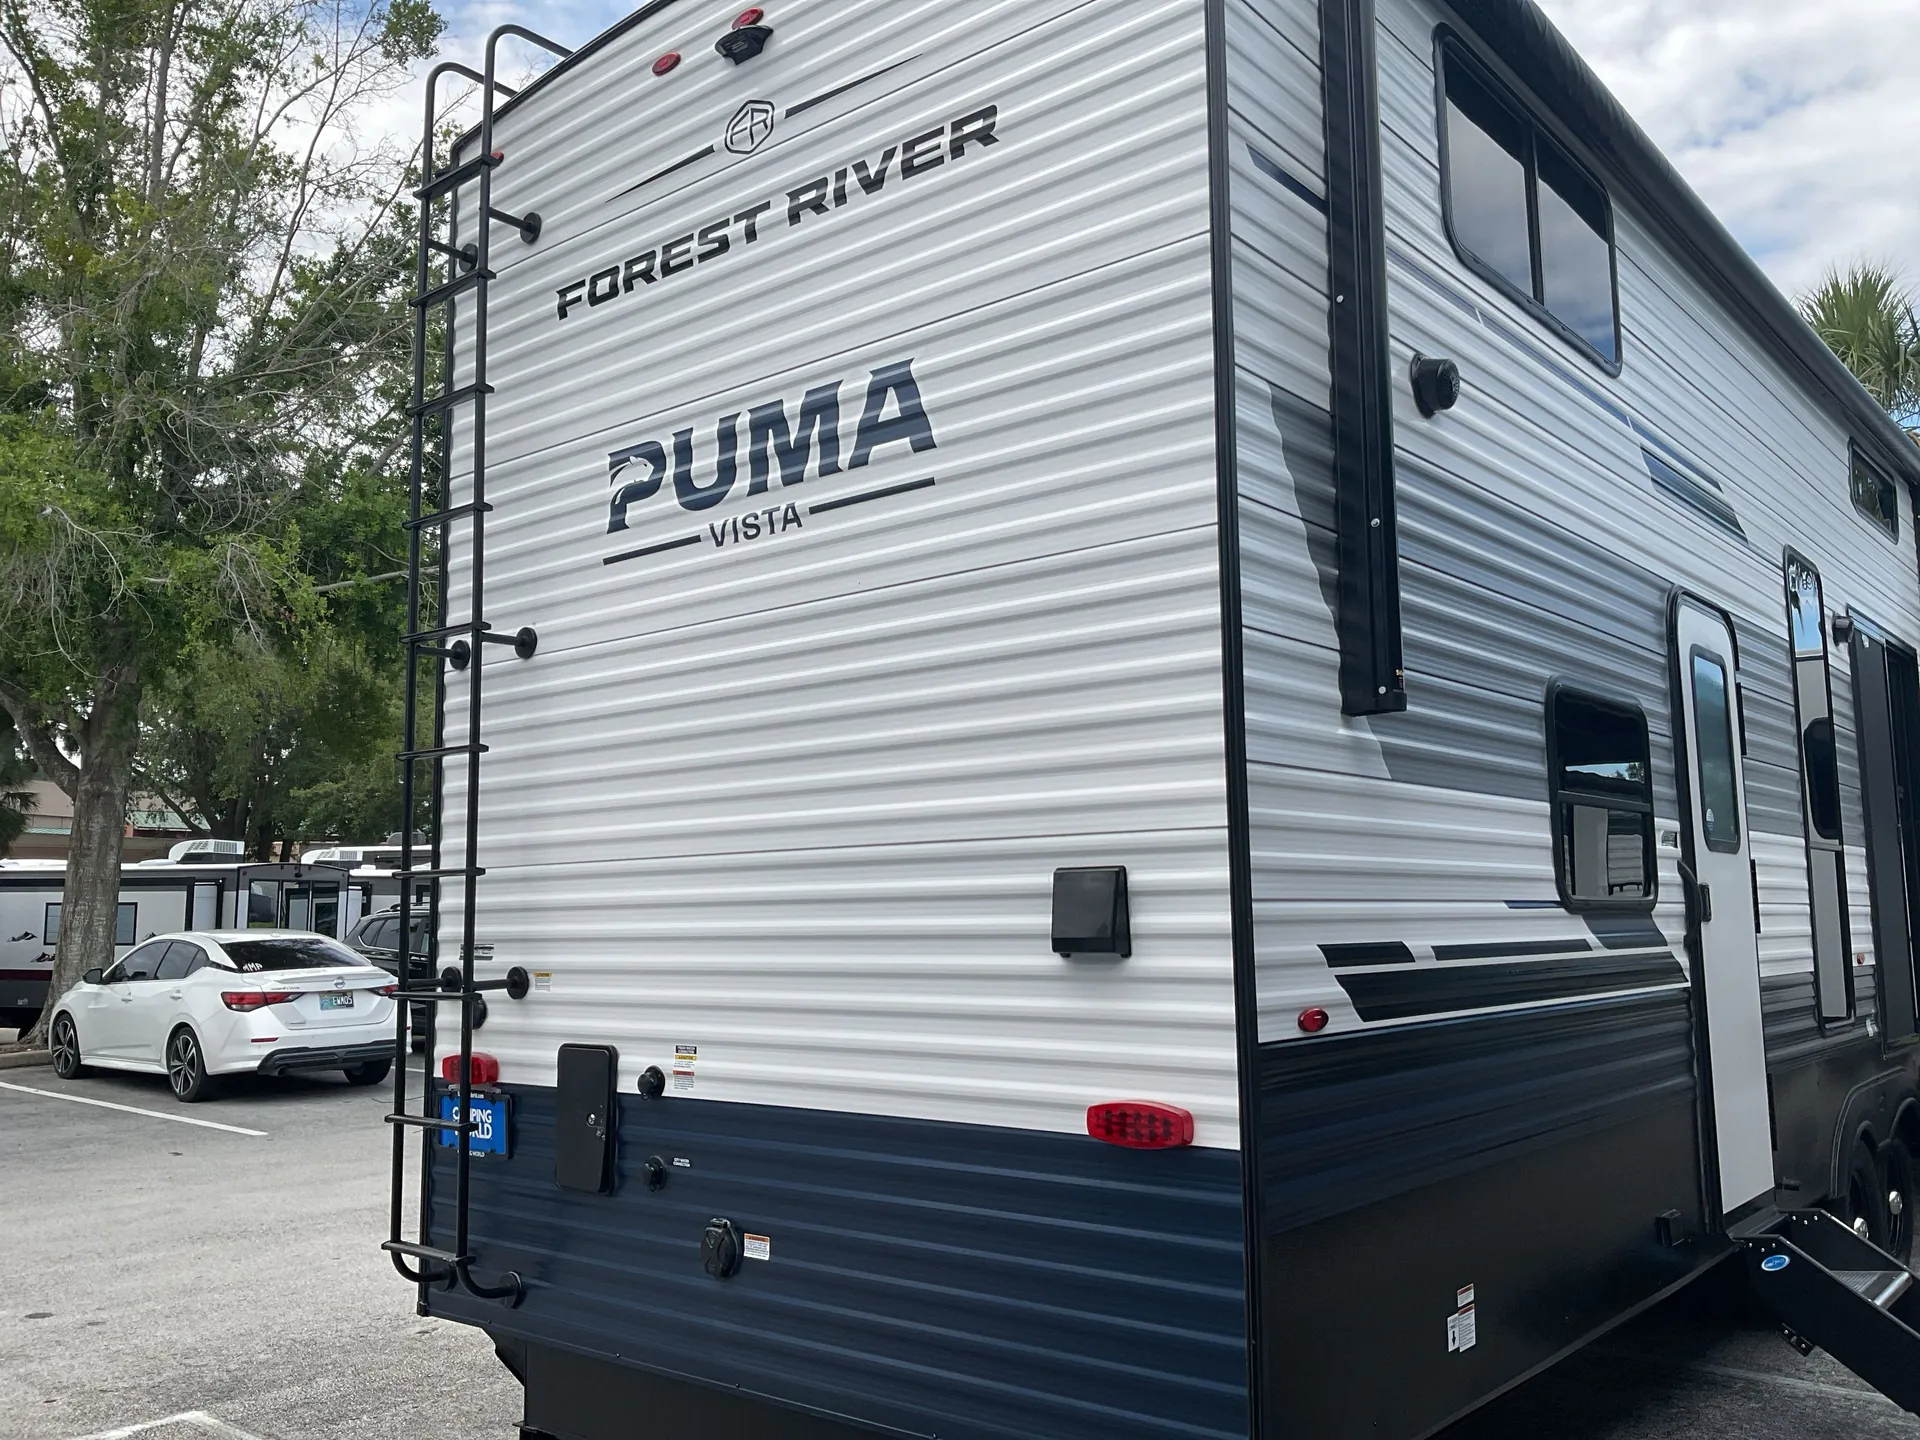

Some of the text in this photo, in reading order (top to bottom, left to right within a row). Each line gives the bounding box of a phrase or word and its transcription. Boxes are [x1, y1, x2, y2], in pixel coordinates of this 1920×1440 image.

[556, 104, 1000, 320] FOREST RIVER
[606, 357, 938, 535] PUMA
[708, 502, 803, 548] VISTA
[452, 1106, 493, 1124] CPING
